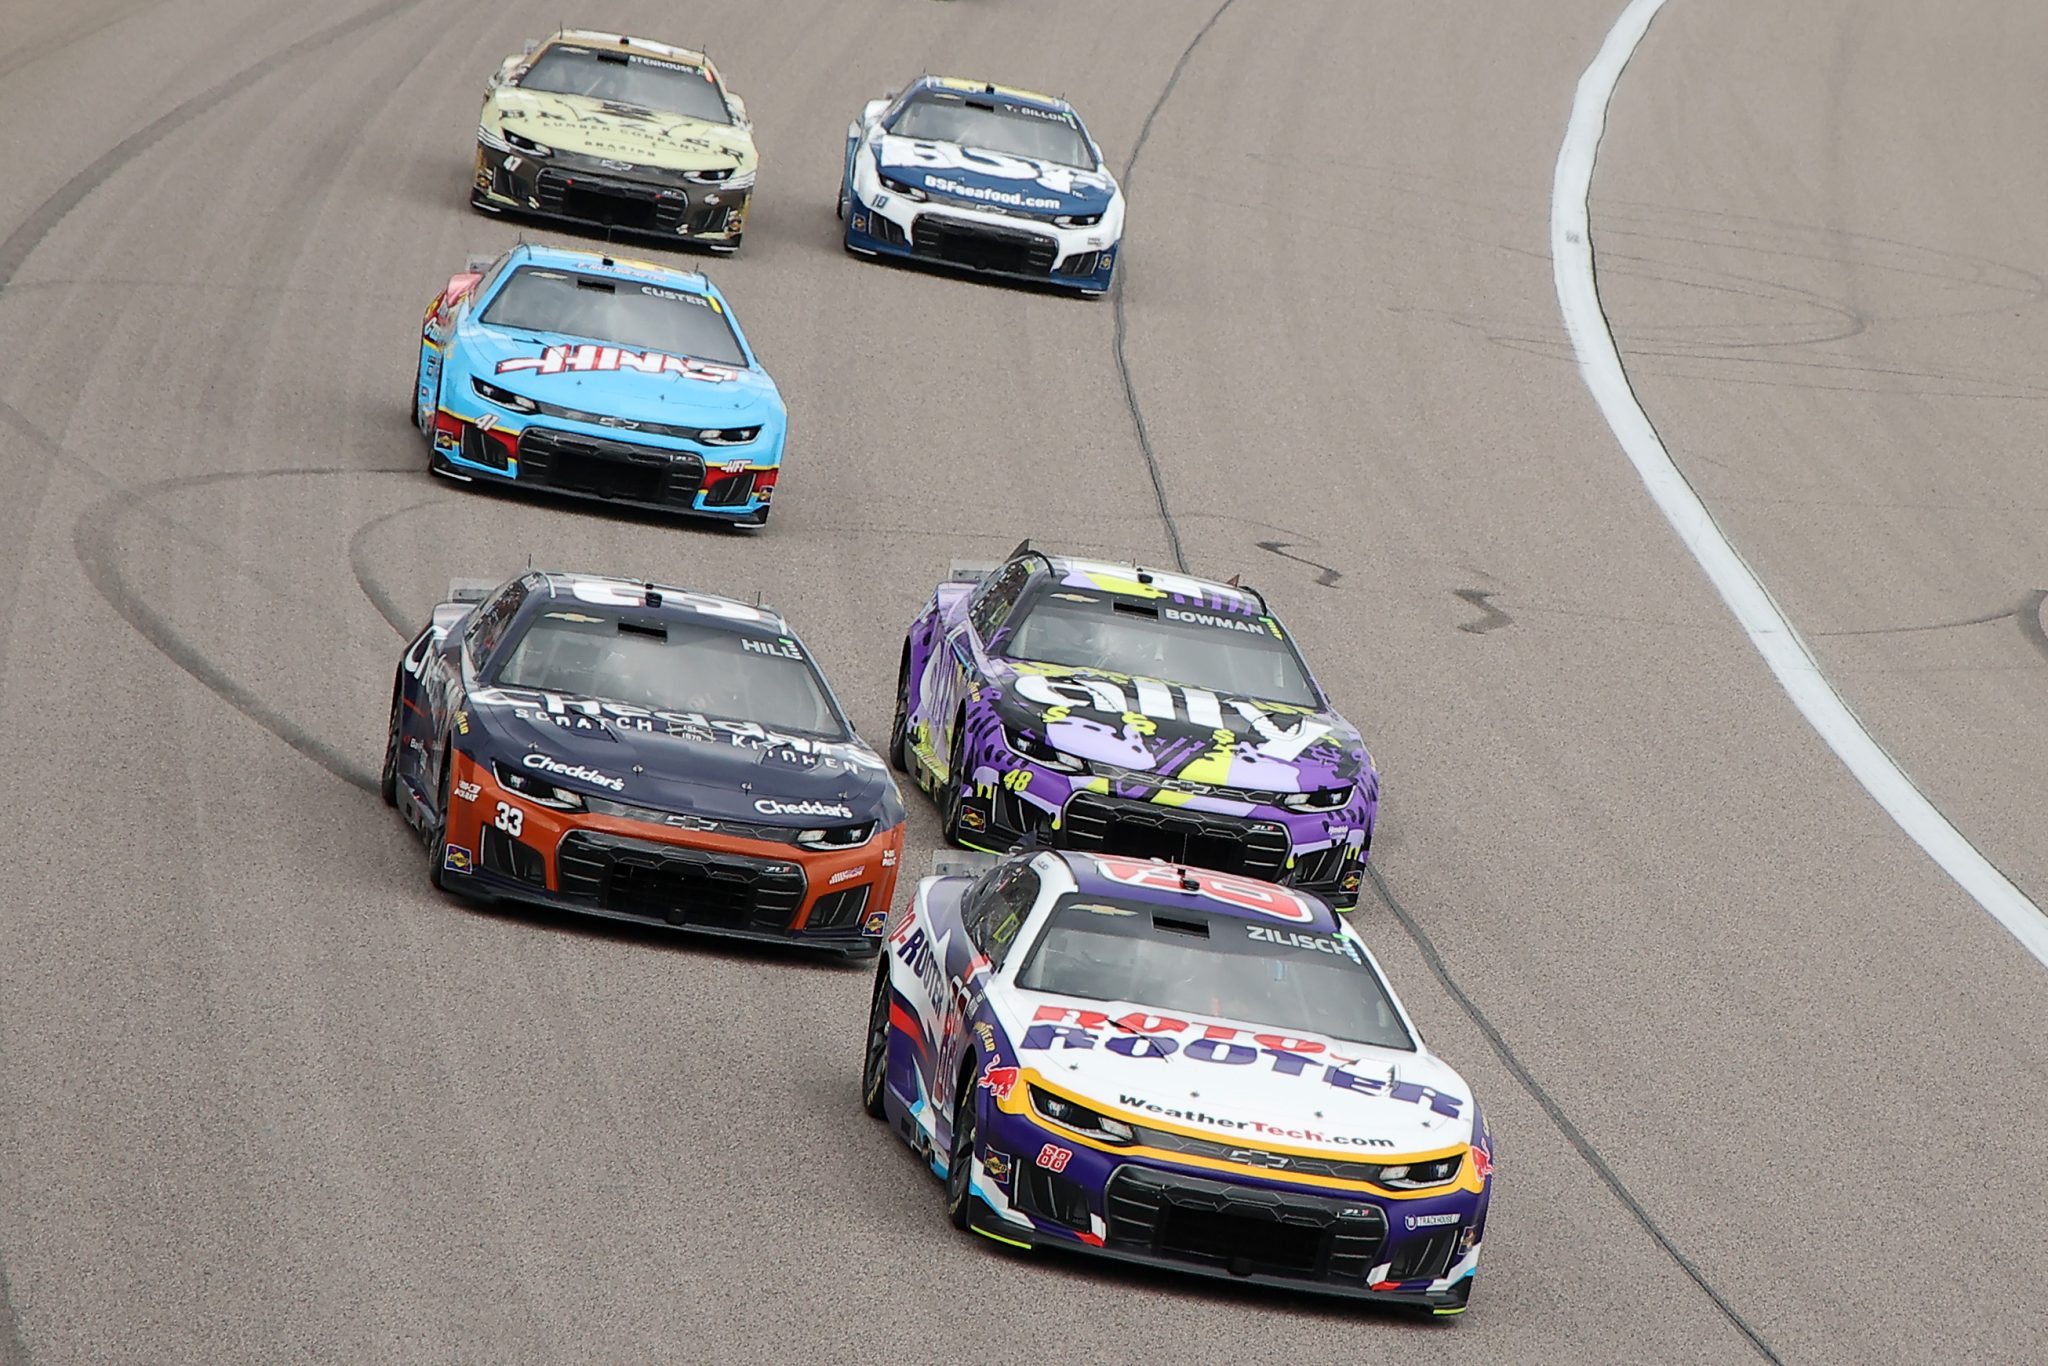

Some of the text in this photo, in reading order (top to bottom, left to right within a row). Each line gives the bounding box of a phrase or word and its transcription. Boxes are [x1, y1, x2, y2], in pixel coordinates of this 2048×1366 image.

[629, 55, 694, 74] STENHOUSE
[1004, 103, 1067, 123] T. DILLON
[542, 122, 700, 152] LUMBER COMPANY
[923, 174, 1061, 210] BSFseafood.com
[641, 286, 708, 308] CUSTER
[474, 412, 500, 432] 41
[1165, 608, 1265, 636] BOWMAN
[522, 753, 626, 793] Cheddar's
[1003, 768, 1034, 792] 48
[494, 801, 524, 838] 33
[753, 799, 854, 819] Cheddar's
[1246, 924, 1347, 955] ZILISCH
[1019, 1024, 1464, 1119] ROOTER
[1118, 1093, 1395, 1148] WeatherTech.com
[1036, 1143, 1073, 1174] 88
